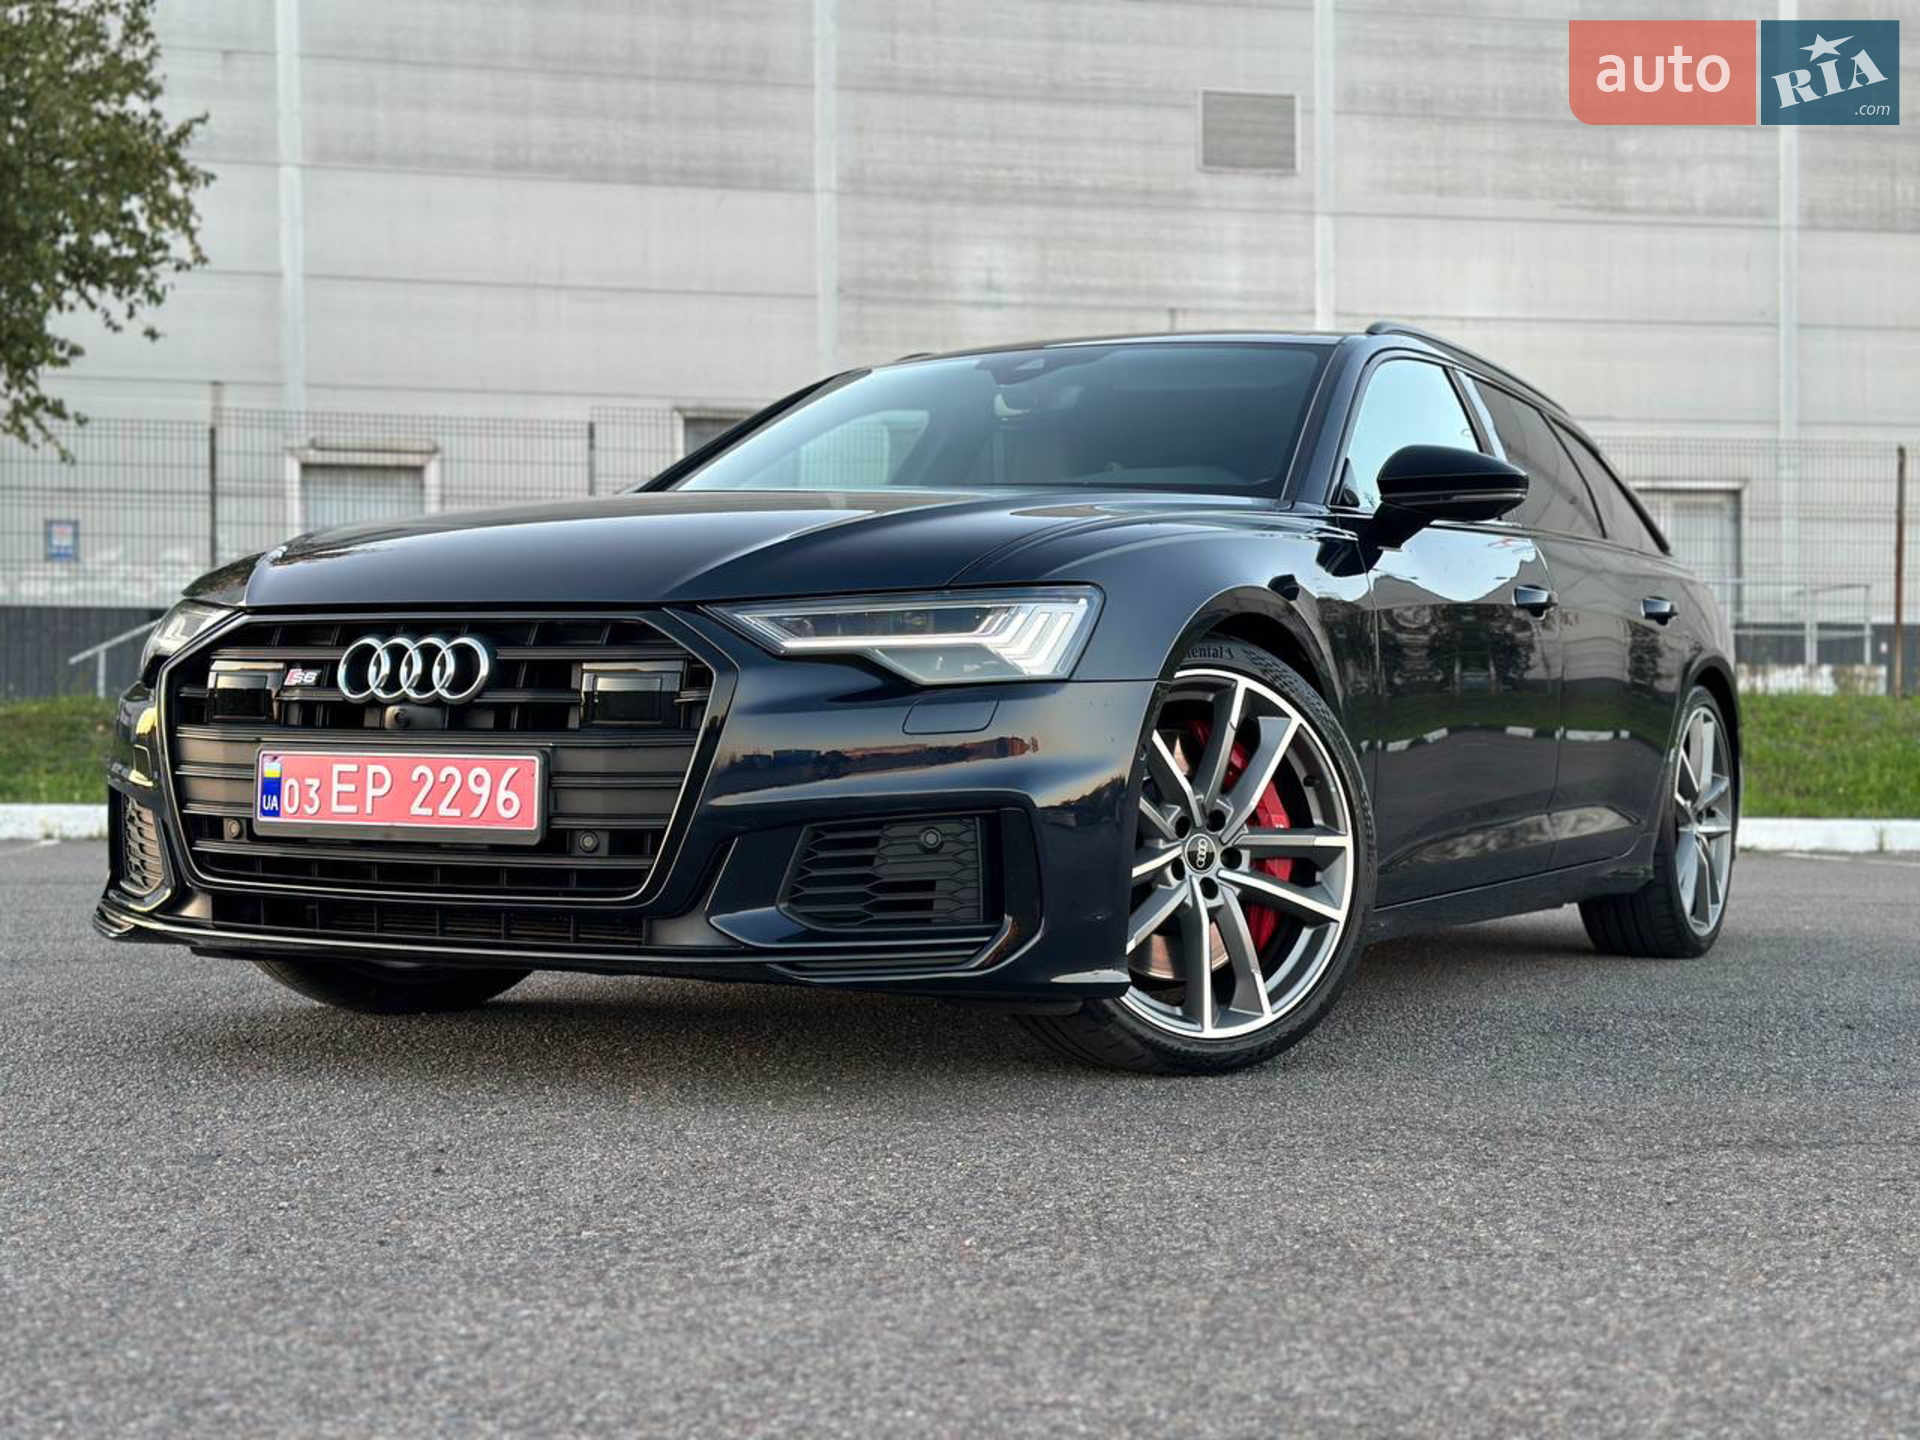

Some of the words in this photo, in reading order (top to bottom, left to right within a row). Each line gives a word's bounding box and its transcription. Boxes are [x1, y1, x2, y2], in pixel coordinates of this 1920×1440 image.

[289, 669, 318, 684] S6
[283, 777, 321, 816] 03
[331, 763, 393, 815] EP
[410, 765, 521, 820] 2296
[262, 794, 279, 811] UA
